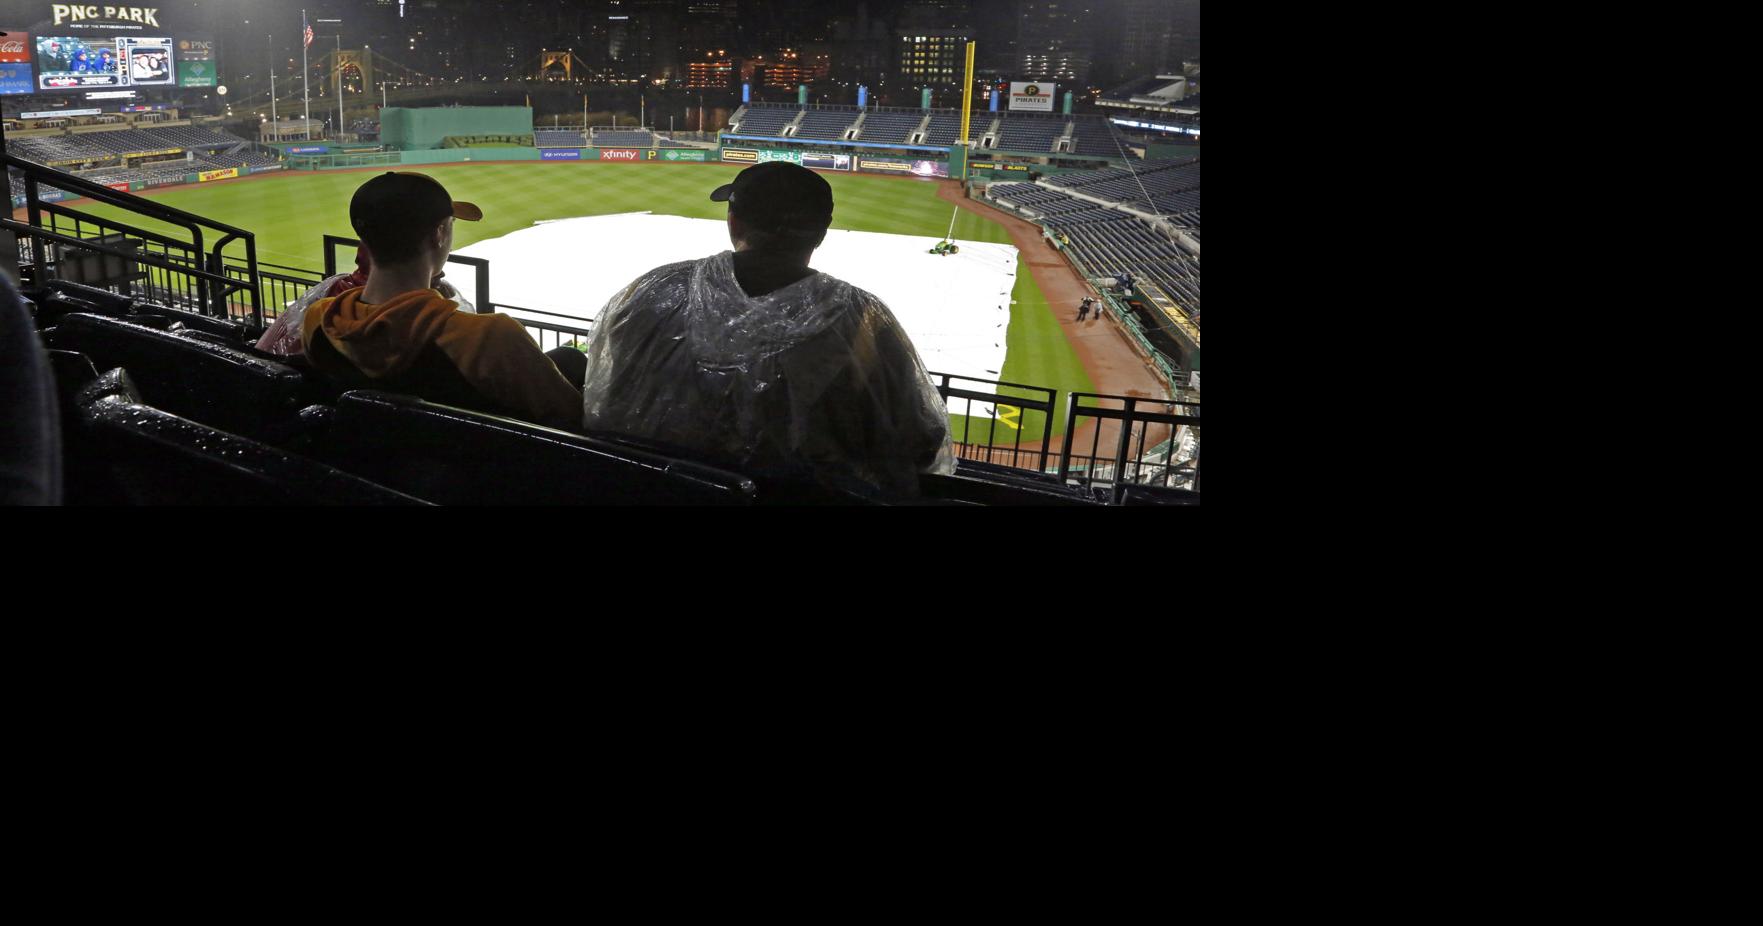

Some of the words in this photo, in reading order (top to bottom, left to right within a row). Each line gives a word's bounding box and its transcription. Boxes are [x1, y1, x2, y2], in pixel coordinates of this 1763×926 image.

[52, 4, 99, 26] PNC
[103, 6, 160, 28] PARK
[191, 40, 213, 49] PNC
[603, 150, 637, 160] xfinity
